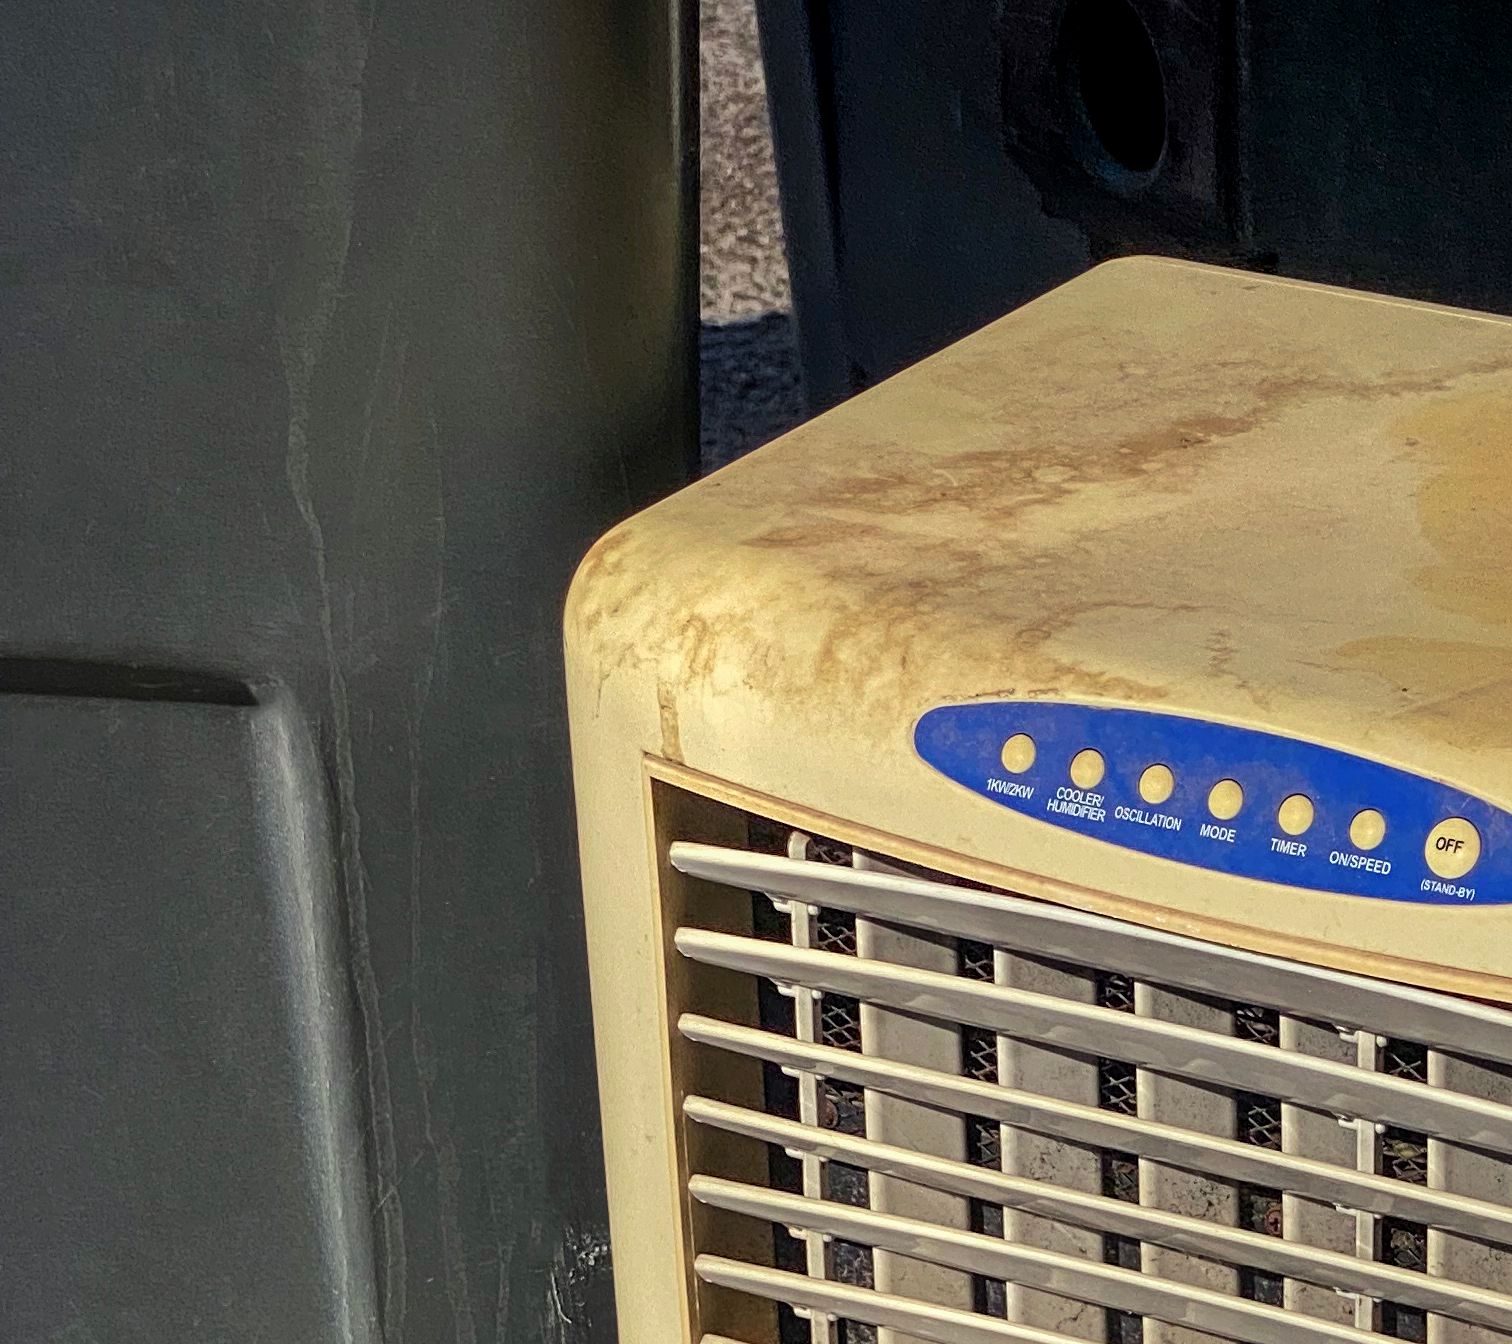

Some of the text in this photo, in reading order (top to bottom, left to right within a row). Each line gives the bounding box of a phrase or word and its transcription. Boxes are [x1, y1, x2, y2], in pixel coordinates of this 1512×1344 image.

[1056, 787, 1105, 807] COOLER/
[1046, 799, 1106, 823] HUMIDIFIER
[1114, 805, 1182, 832] OSCILLATION
[1199, 823, 1237, 843] MODE
[1270, 837, 1308, 858] TIMER
[1435, 836, 1465, 854] OFF
[1329, 850, 1392, 876] ON/SPEED
[1420, 878, 1476, 901] (STAND-BY)
